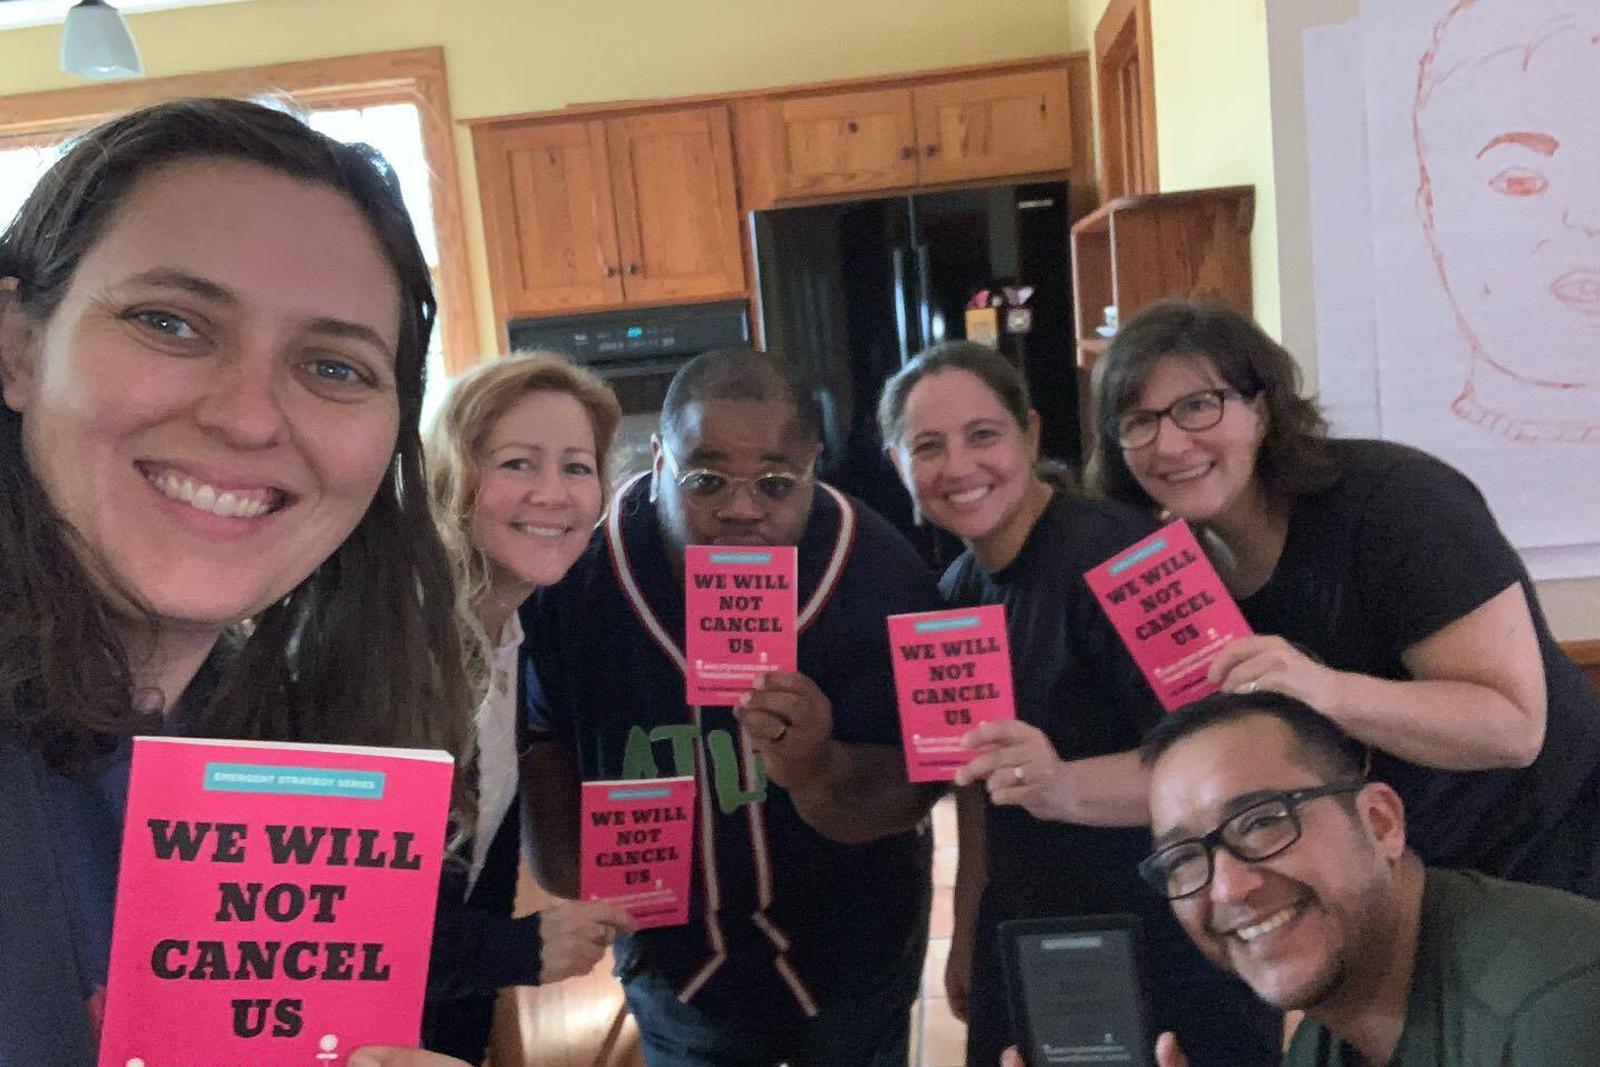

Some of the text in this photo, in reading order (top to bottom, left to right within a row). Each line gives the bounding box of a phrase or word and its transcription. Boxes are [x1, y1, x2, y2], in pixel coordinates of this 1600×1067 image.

[694, 574, 789, 589] WE WILL
[1106, 580, 1141, 605] WE
[1140, 550, 1197, 585] WILL
[719, 596, 763, 611] NOT
[1140, 580, 1183, 613] NOT
[701, 617, 783, 632] CANCEL
[1136, 591, 1215, 640] CANCEL
[1172, 623, 1200, 646] US
[729, 638, 754, 653] US
[900, 637, 1001, 660] WE WILL
[929, 662, 976, 681] NOT
[912, 683, 1000, 704] CANCEL
[944, 709, 972, 726] US
[591, 807, 687, 826] WE WILL
[147, 818, 422, 870] WE WILL
[616, 828, 662, 845] NOT
[596, 847, 679, 867] CANCEL
[624, 870, 650, 885] US
[215, 883, 347, 923] NOT
[151, 939, 391, 982] CANCEL
[231, 998, 304, 1038] US
